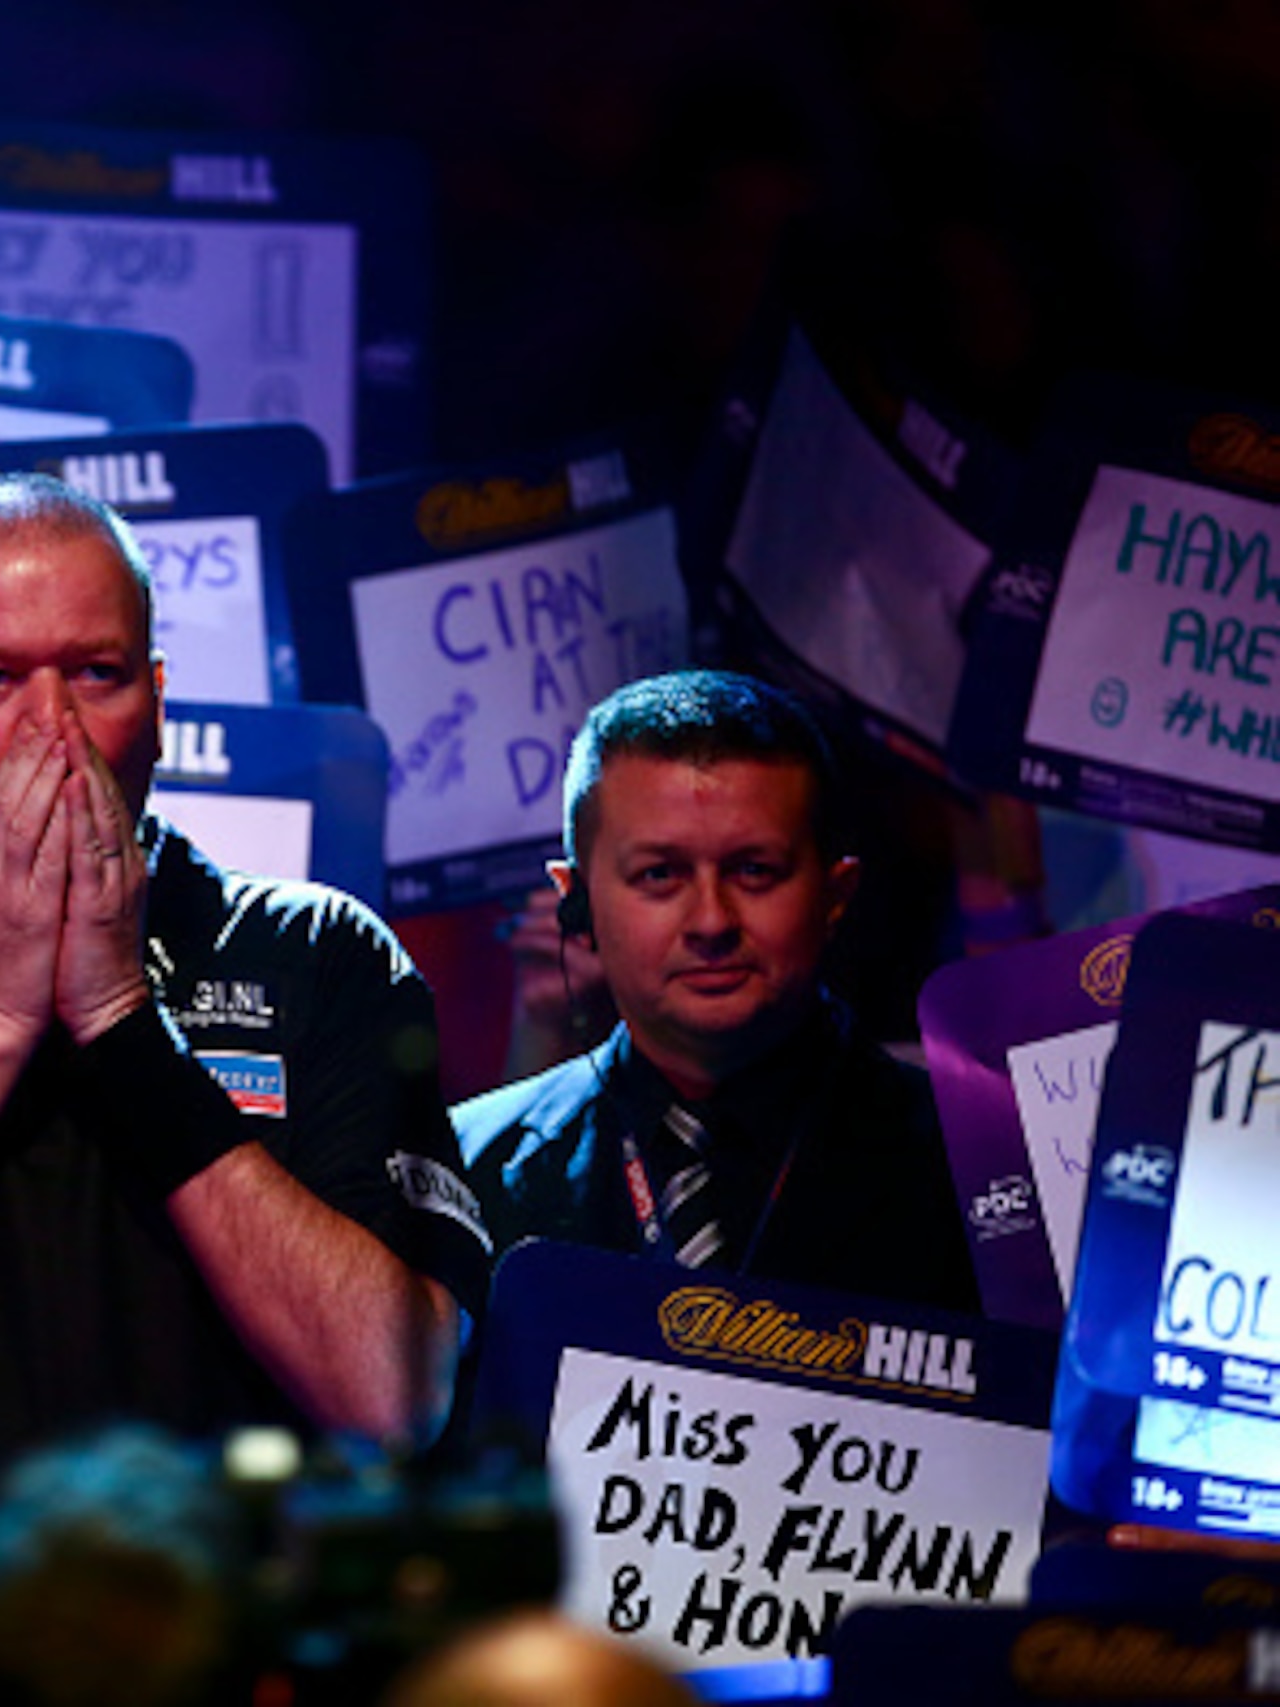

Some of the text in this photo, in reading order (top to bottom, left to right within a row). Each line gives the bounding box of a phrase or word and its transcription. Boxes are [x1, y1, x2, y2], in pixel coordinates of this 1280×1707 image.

[166, 152, 277, 204] HILL
[62, 450, 177, 505] HILL
[1160, 608, 1270, 686] ARE
[162, 719, 231, 774] ILL
[657, 1285, 979, 1395] William HILL
[781, 1422, 921, 1494] YOU
[595, 1475, 1012, 1600] DAD, FLYNN
[608, 1565, 651, 1633] &
